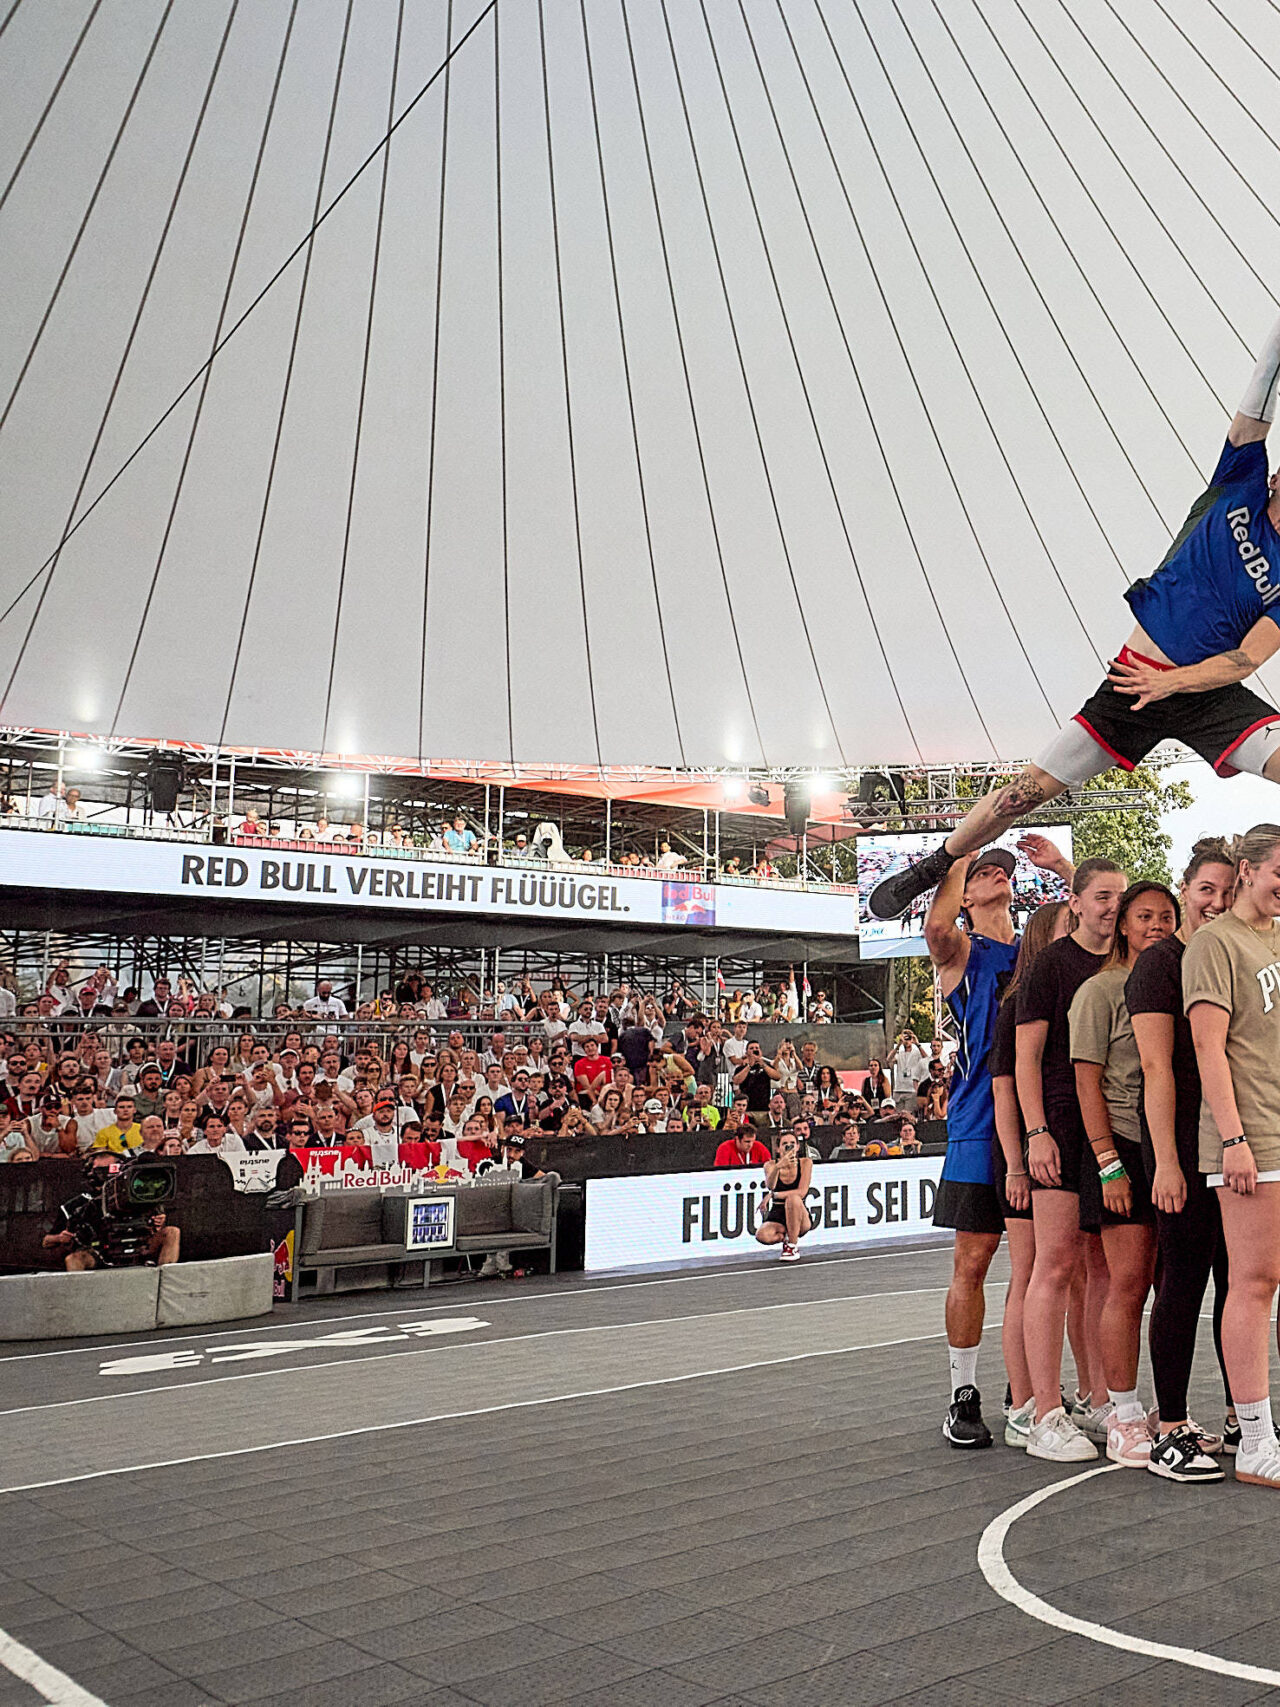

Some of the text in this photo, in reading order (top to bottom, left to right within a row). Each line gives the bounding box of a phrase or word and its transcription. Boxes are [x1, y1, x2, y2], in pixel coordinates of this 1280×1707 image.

[1227, 506, 1260, 560] Red
[182, 854, 631, 914] RED BULL VERLEIHT FLÜÜÜGEL.
[344, 1168, 411, 1187] Red Bull
[682, 1181, 856, 1243] FLÜÜGEL
[867, 1180, 908, 1224] SEI
